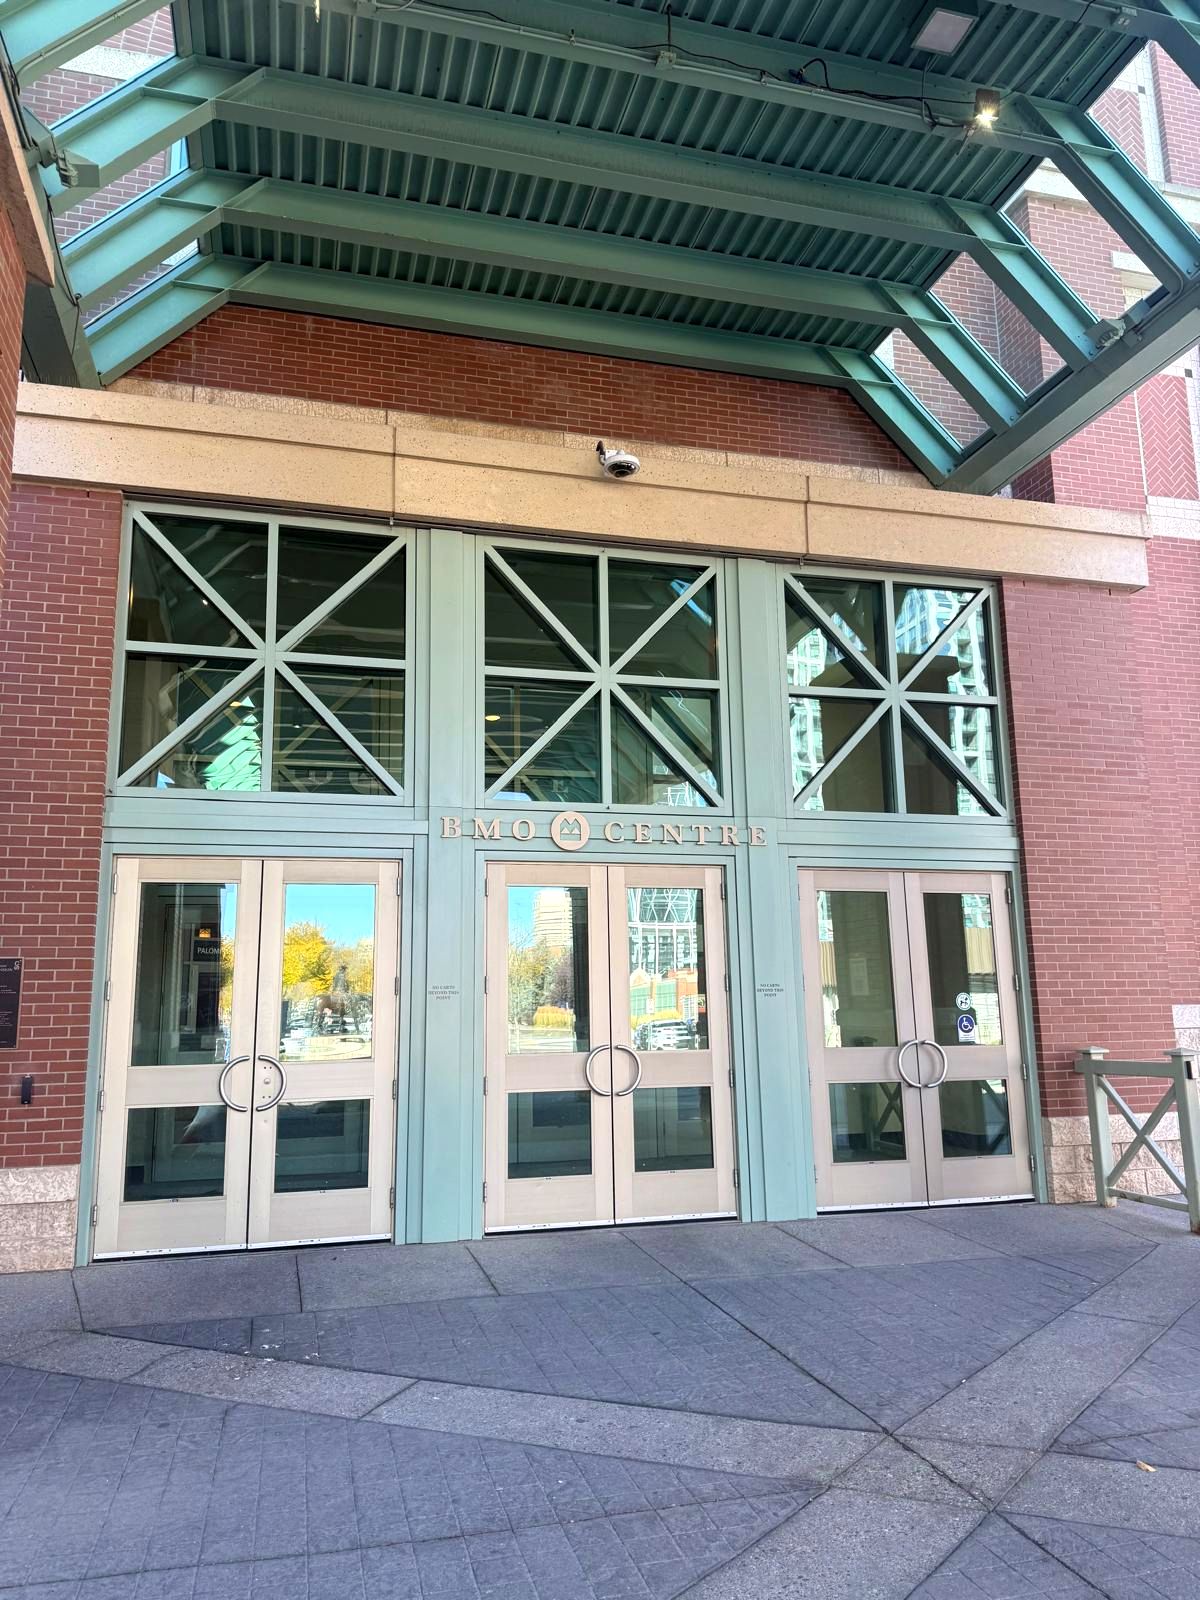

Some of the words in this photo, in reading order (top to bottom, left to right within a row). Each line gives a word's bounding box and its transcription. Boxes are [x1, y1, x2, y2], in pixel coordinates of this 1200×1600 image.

[440, 815, 536, 841] BMO
[604, 821, 768, 846] CENTRE
[197, 946, 220, 955] PALOM
